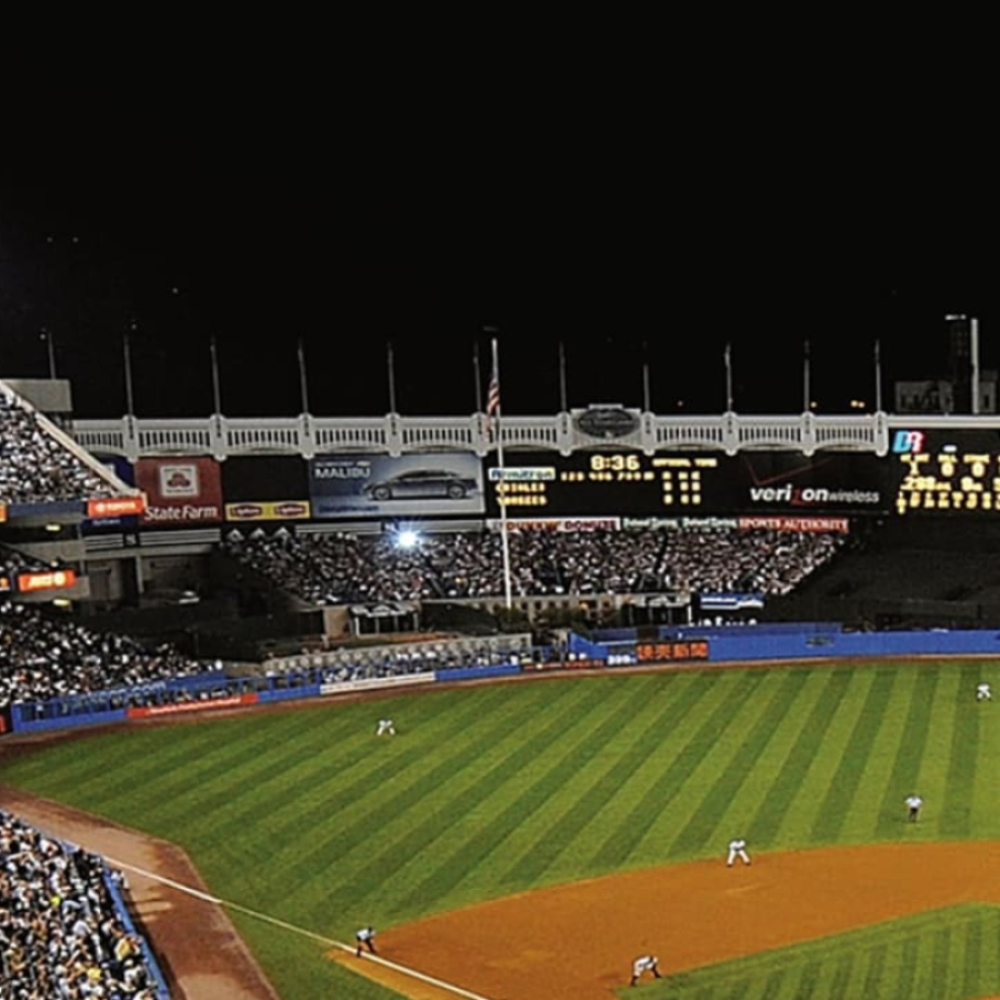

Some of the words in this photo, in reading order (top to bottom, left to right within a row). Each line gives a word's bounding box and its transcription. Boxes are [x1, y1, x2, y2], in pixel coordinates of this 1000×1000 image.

[590, 454, 640, 471] 8:36
[315, 467, 370, 478] MALIBU
[751, 484, 829, 505] verizon
[829, 488, 879, 503] wireless
[144, 505, 181, 521] State
[182, 504, 218, 520] Farm
